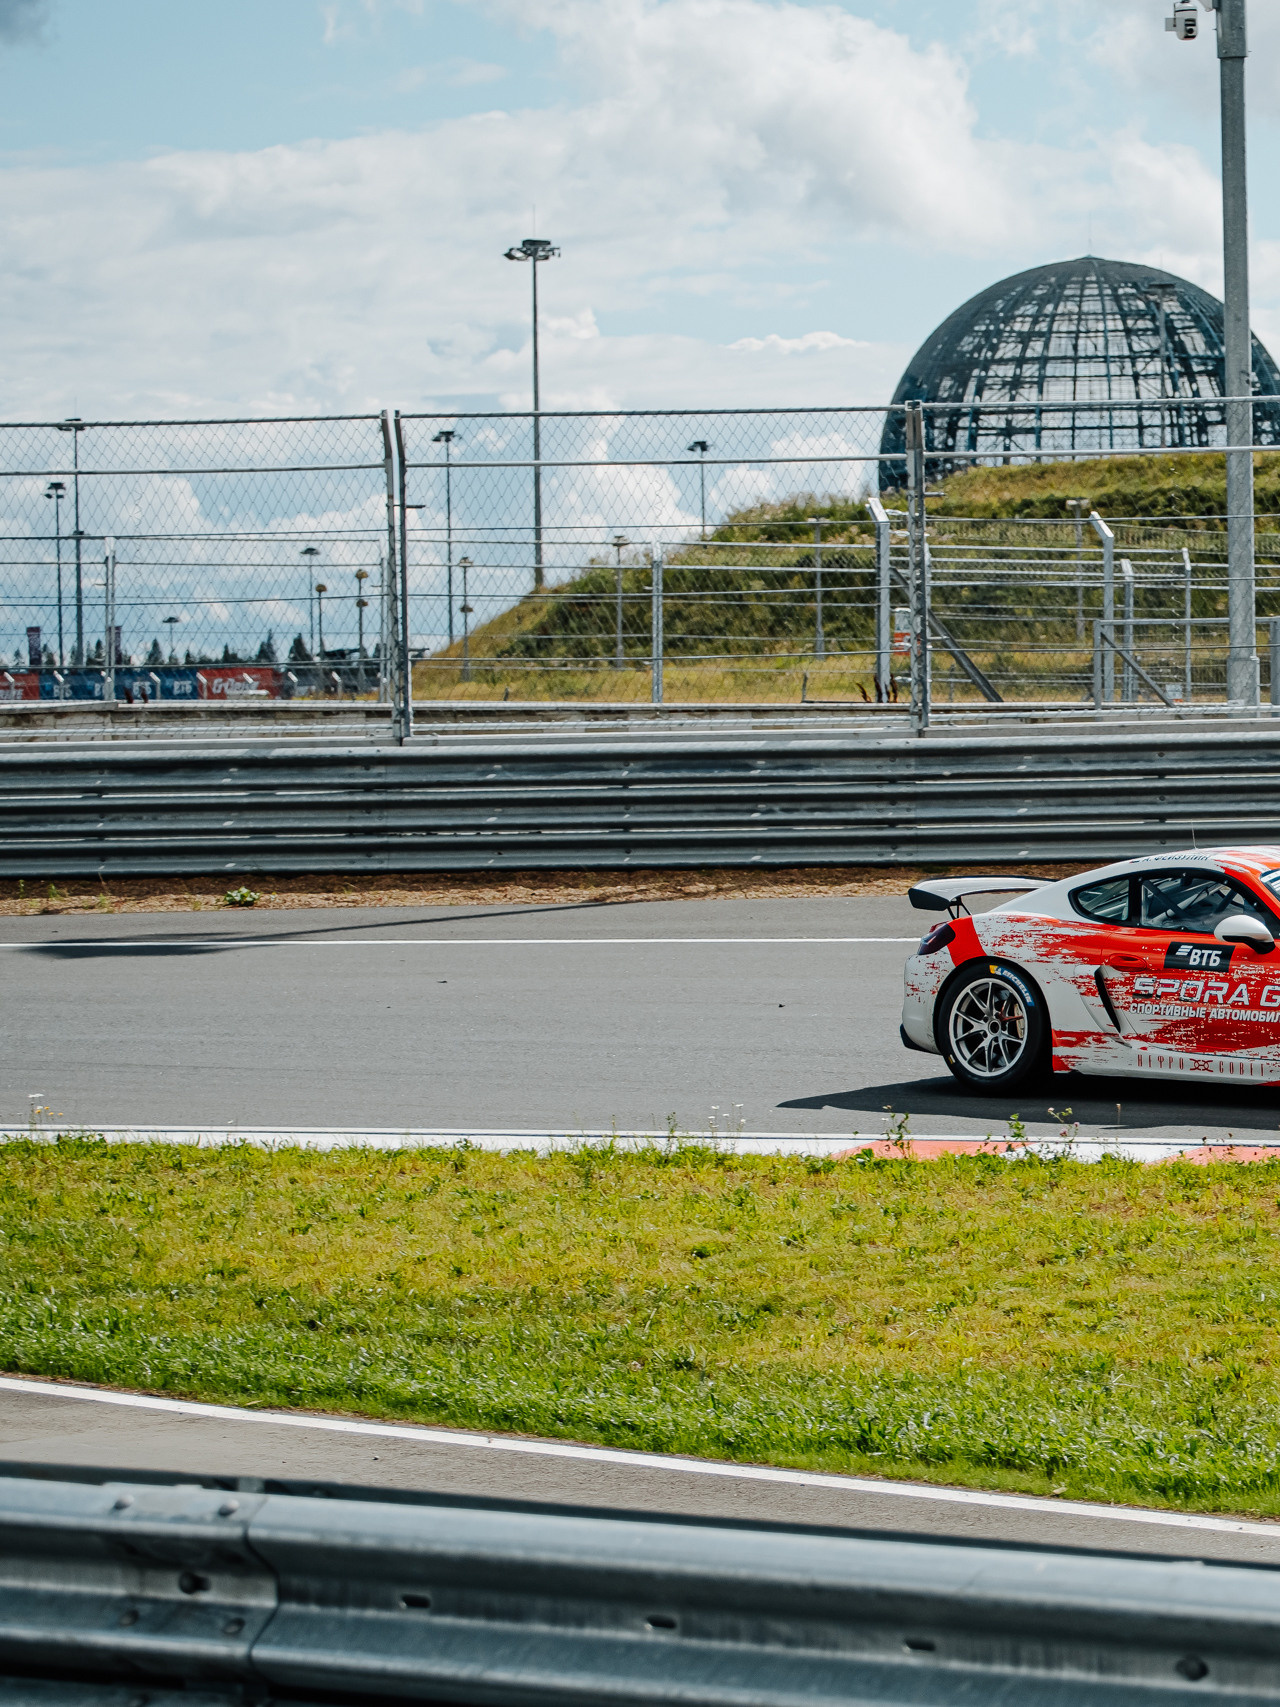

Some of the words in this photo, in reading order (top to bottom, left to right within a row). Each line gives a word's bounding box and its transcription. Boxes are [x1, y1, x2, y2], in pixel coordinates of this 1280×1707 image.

[1188, 949, 1223, 967] ВТБ
[1133, 977, 1250, 1006] SPORA
[1129, 1003, 1206, 1018] СПОРТИВНЫЕ
